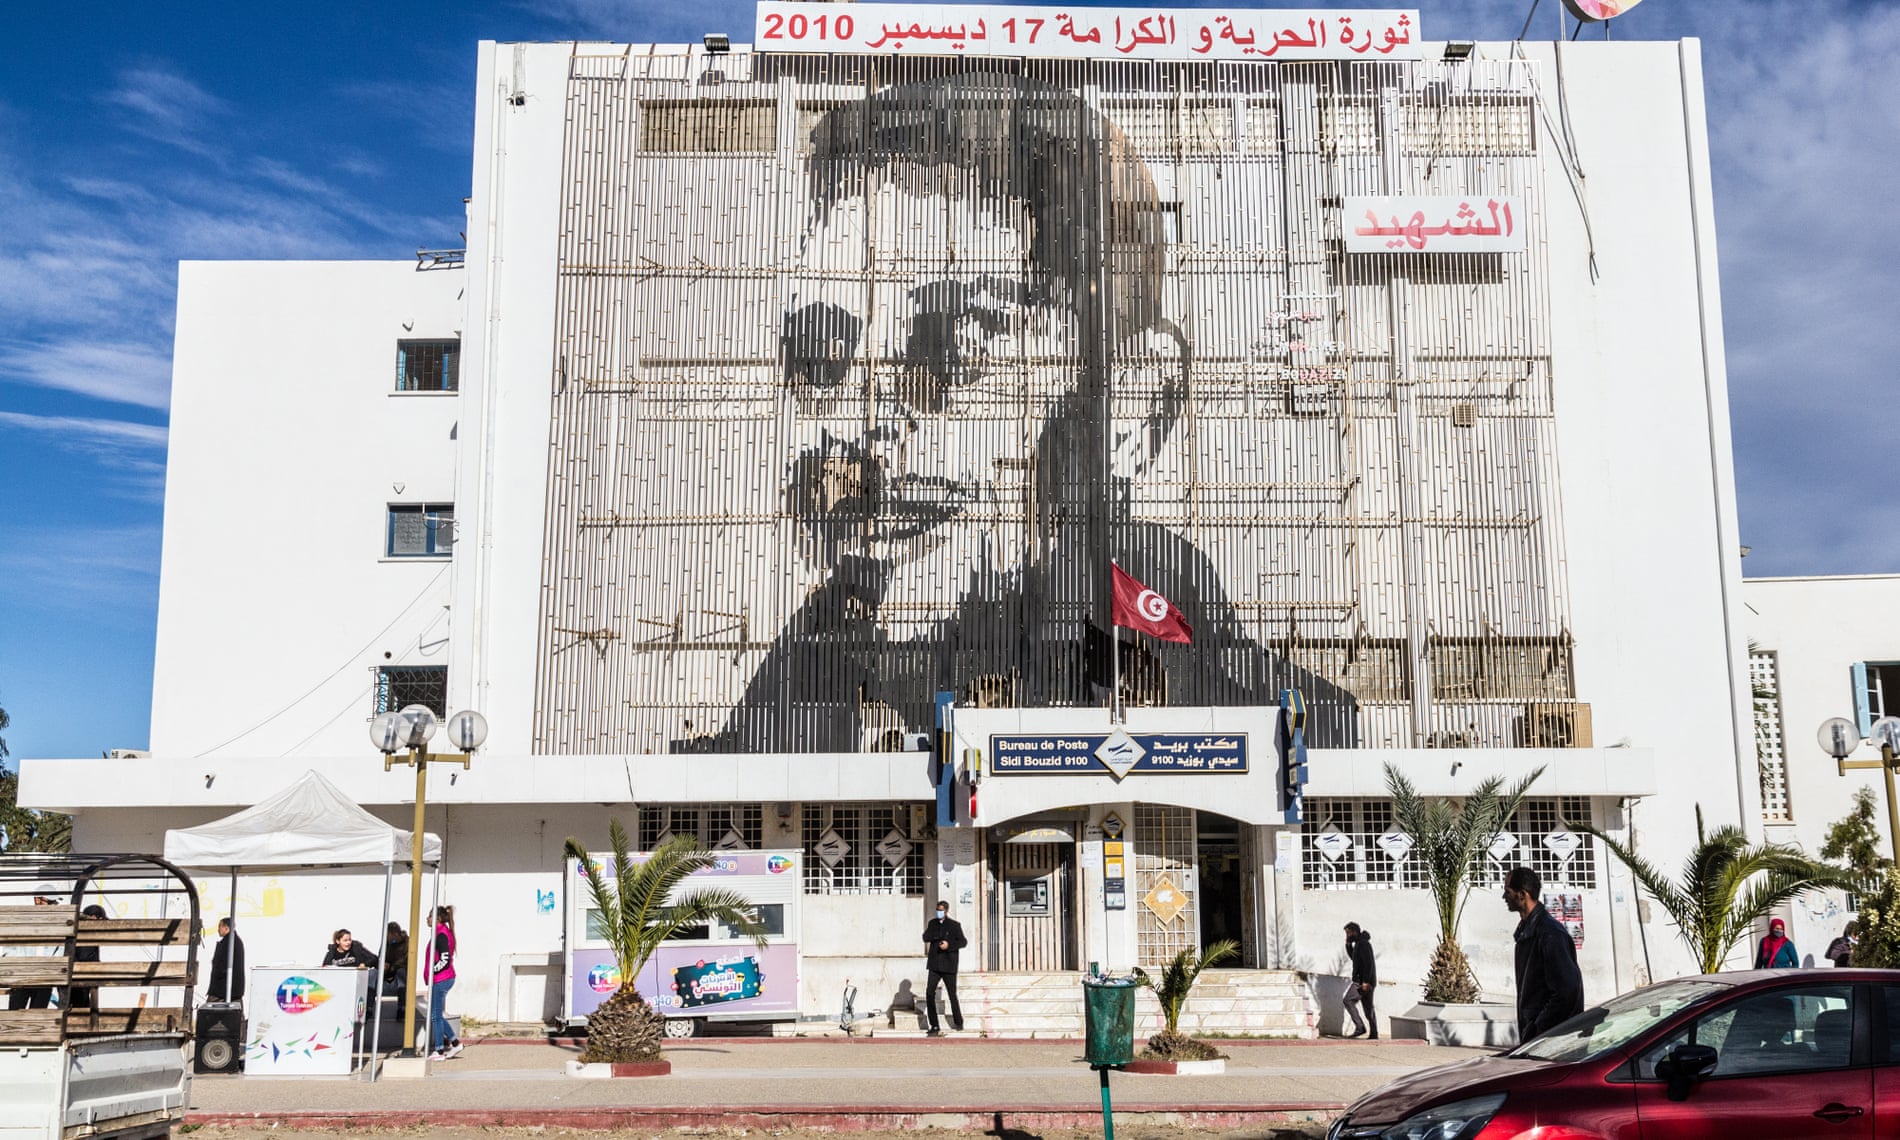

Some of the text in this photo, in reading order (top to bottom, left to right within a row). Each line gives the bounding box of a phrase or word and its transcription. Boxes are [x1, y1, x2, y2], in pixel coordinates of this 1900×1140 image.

[763, 13, 855, 40] 2010
[867, 18, 987, 50] ديسمبر
[1002, 18, 1044, 43] 17
[1339, 14, 1410, 54] ثورة
[1355, 197, 1514, 250] الشهيد
[999, 739, 1089, 750] Bureau de Poste
[1153, 737, 1238, 753] مكتب بريد
[1000, 756, 1088, 766] Sidi Bouzid 9100
[1152, 755, 1239, 769] سيدي بوزيد 9100
[591, 970, 616, 984] TT
[282, 984, 314, 1003] TT
